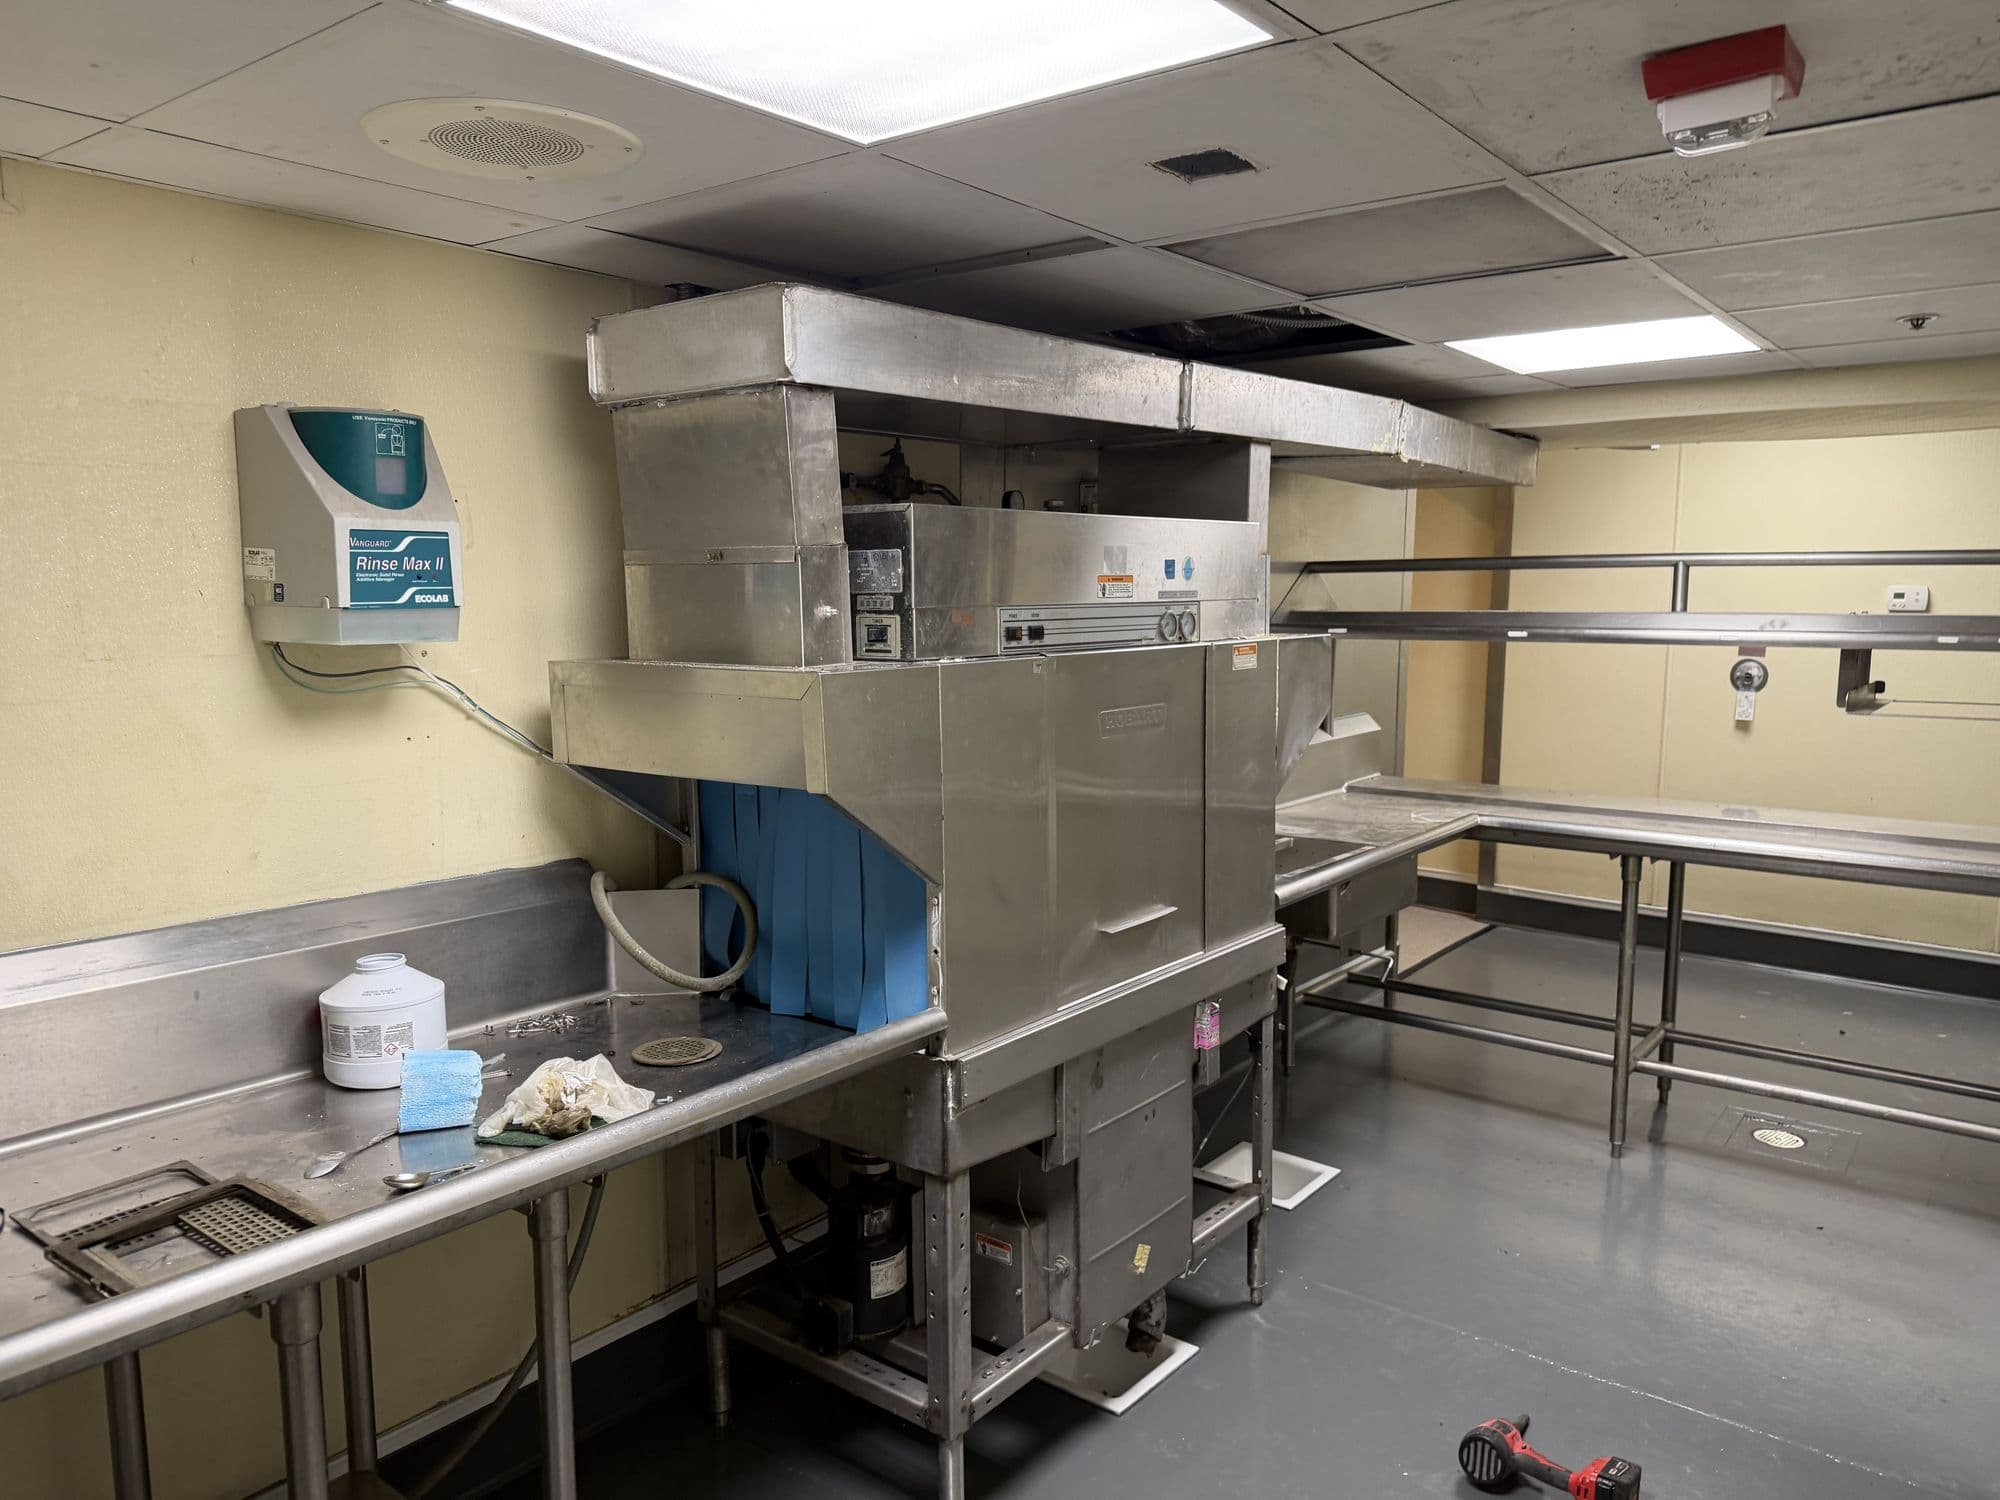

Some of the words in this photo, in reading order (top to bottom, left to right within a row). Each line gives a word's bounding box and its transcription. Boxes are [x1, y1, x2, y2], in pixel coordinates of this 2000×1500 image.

[350, 537, 390, 547] VANGUARD
[356, 556, 398, 571] Rinse
[403, 556, 431, 571] Max
[435, 556, 444, 571] II
[414, 594, 449, 603] ECOLAB
